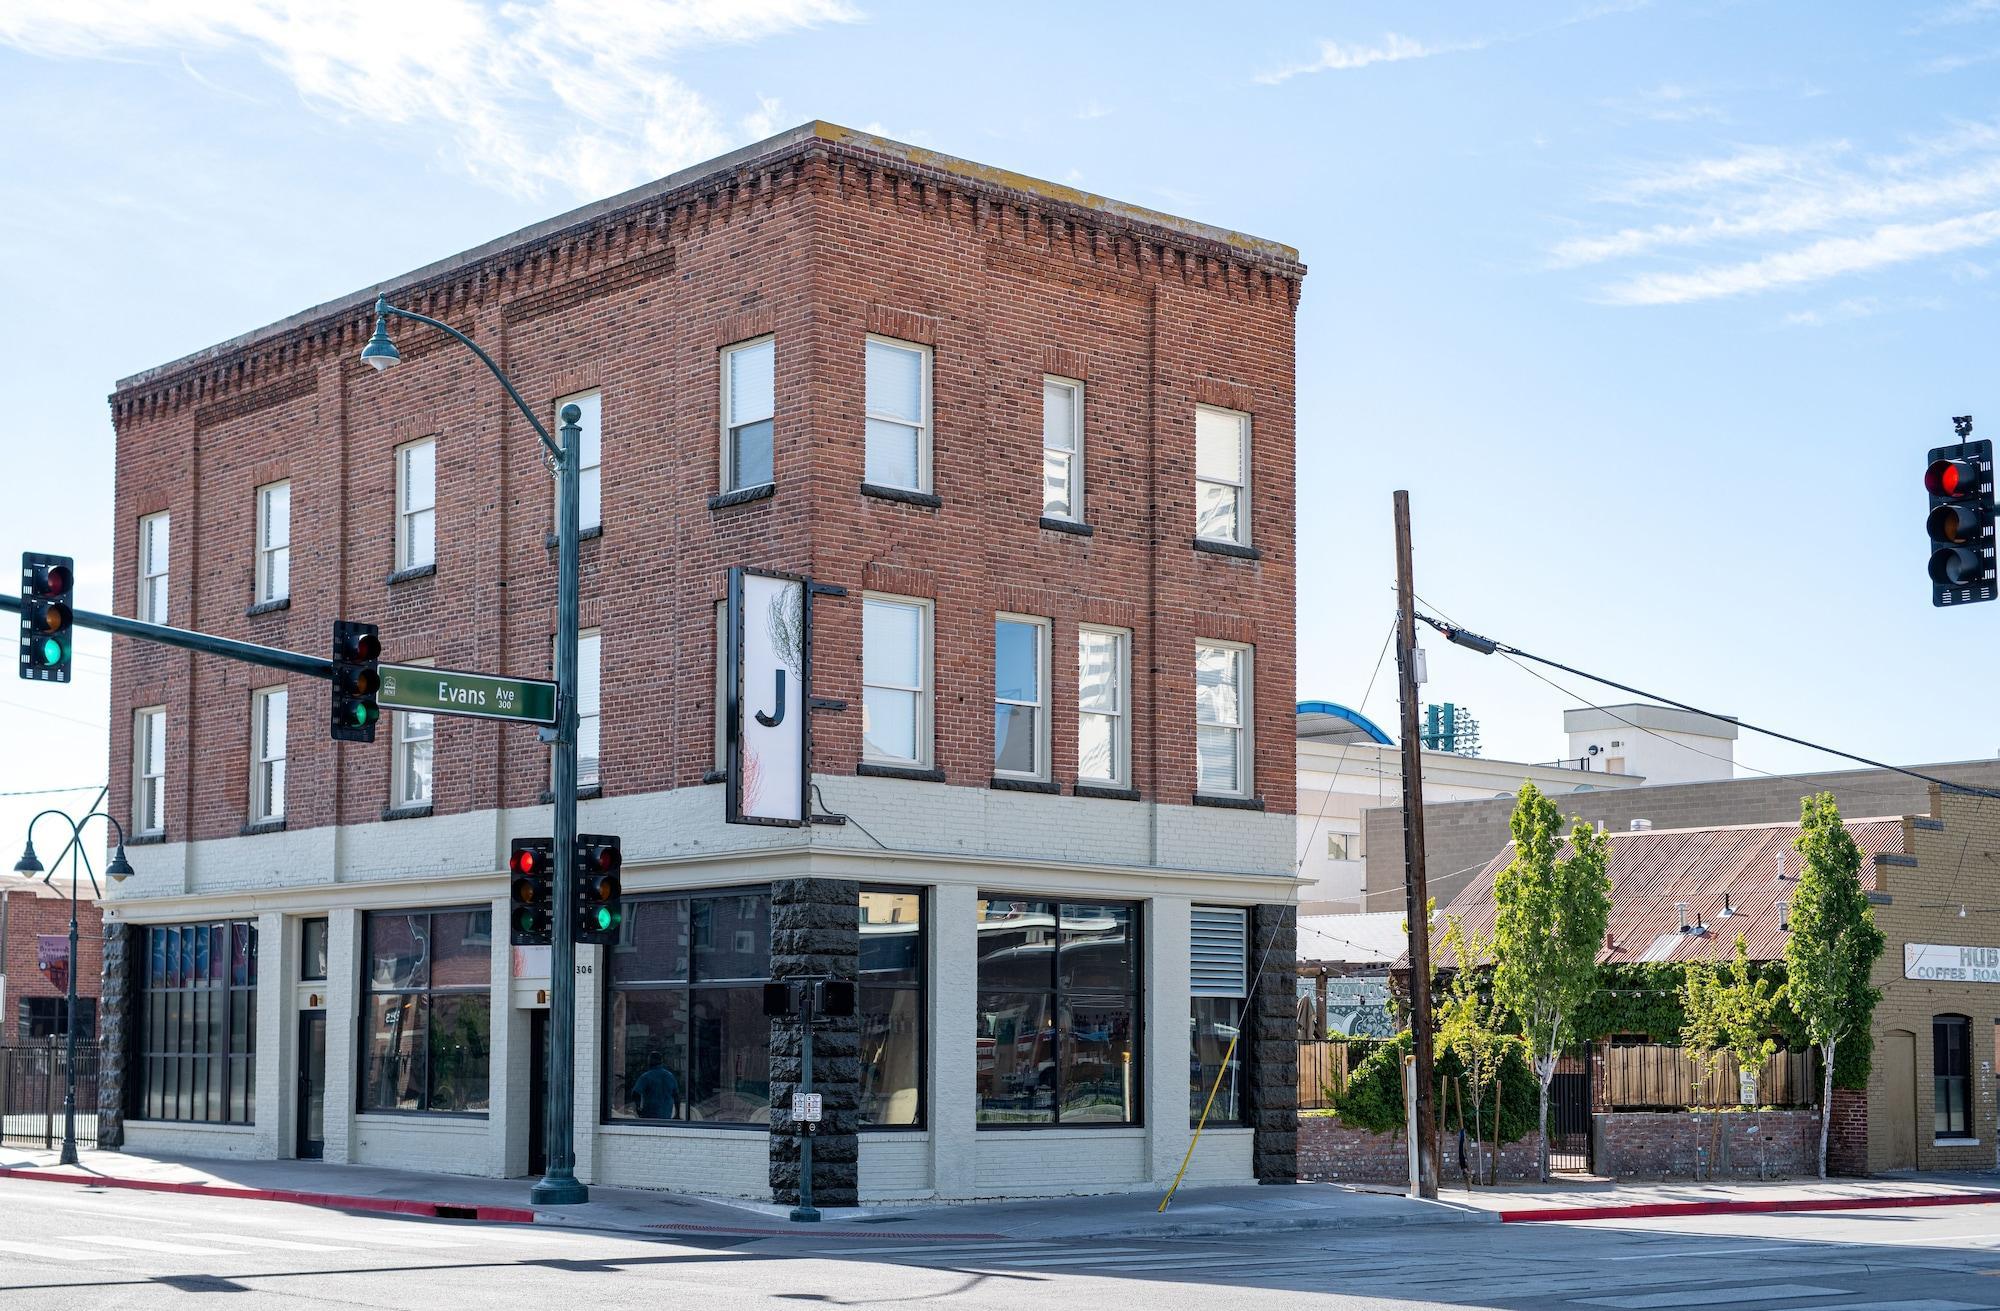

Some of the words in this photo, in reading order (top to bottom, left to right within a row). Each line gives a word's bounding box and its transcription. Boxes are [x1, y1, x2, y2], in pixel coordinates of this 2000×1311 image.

[438, 681, 486, 706] Evans
[495, 686, 515, 701] Ave
[755, 670, 786, 728] J
[498, 700, 512, 710] 300
[1960, 947, 2000, 969] HUB
[576, 965, 592, 974] 306
[1917, 967, 1966, 979] COFFEE
